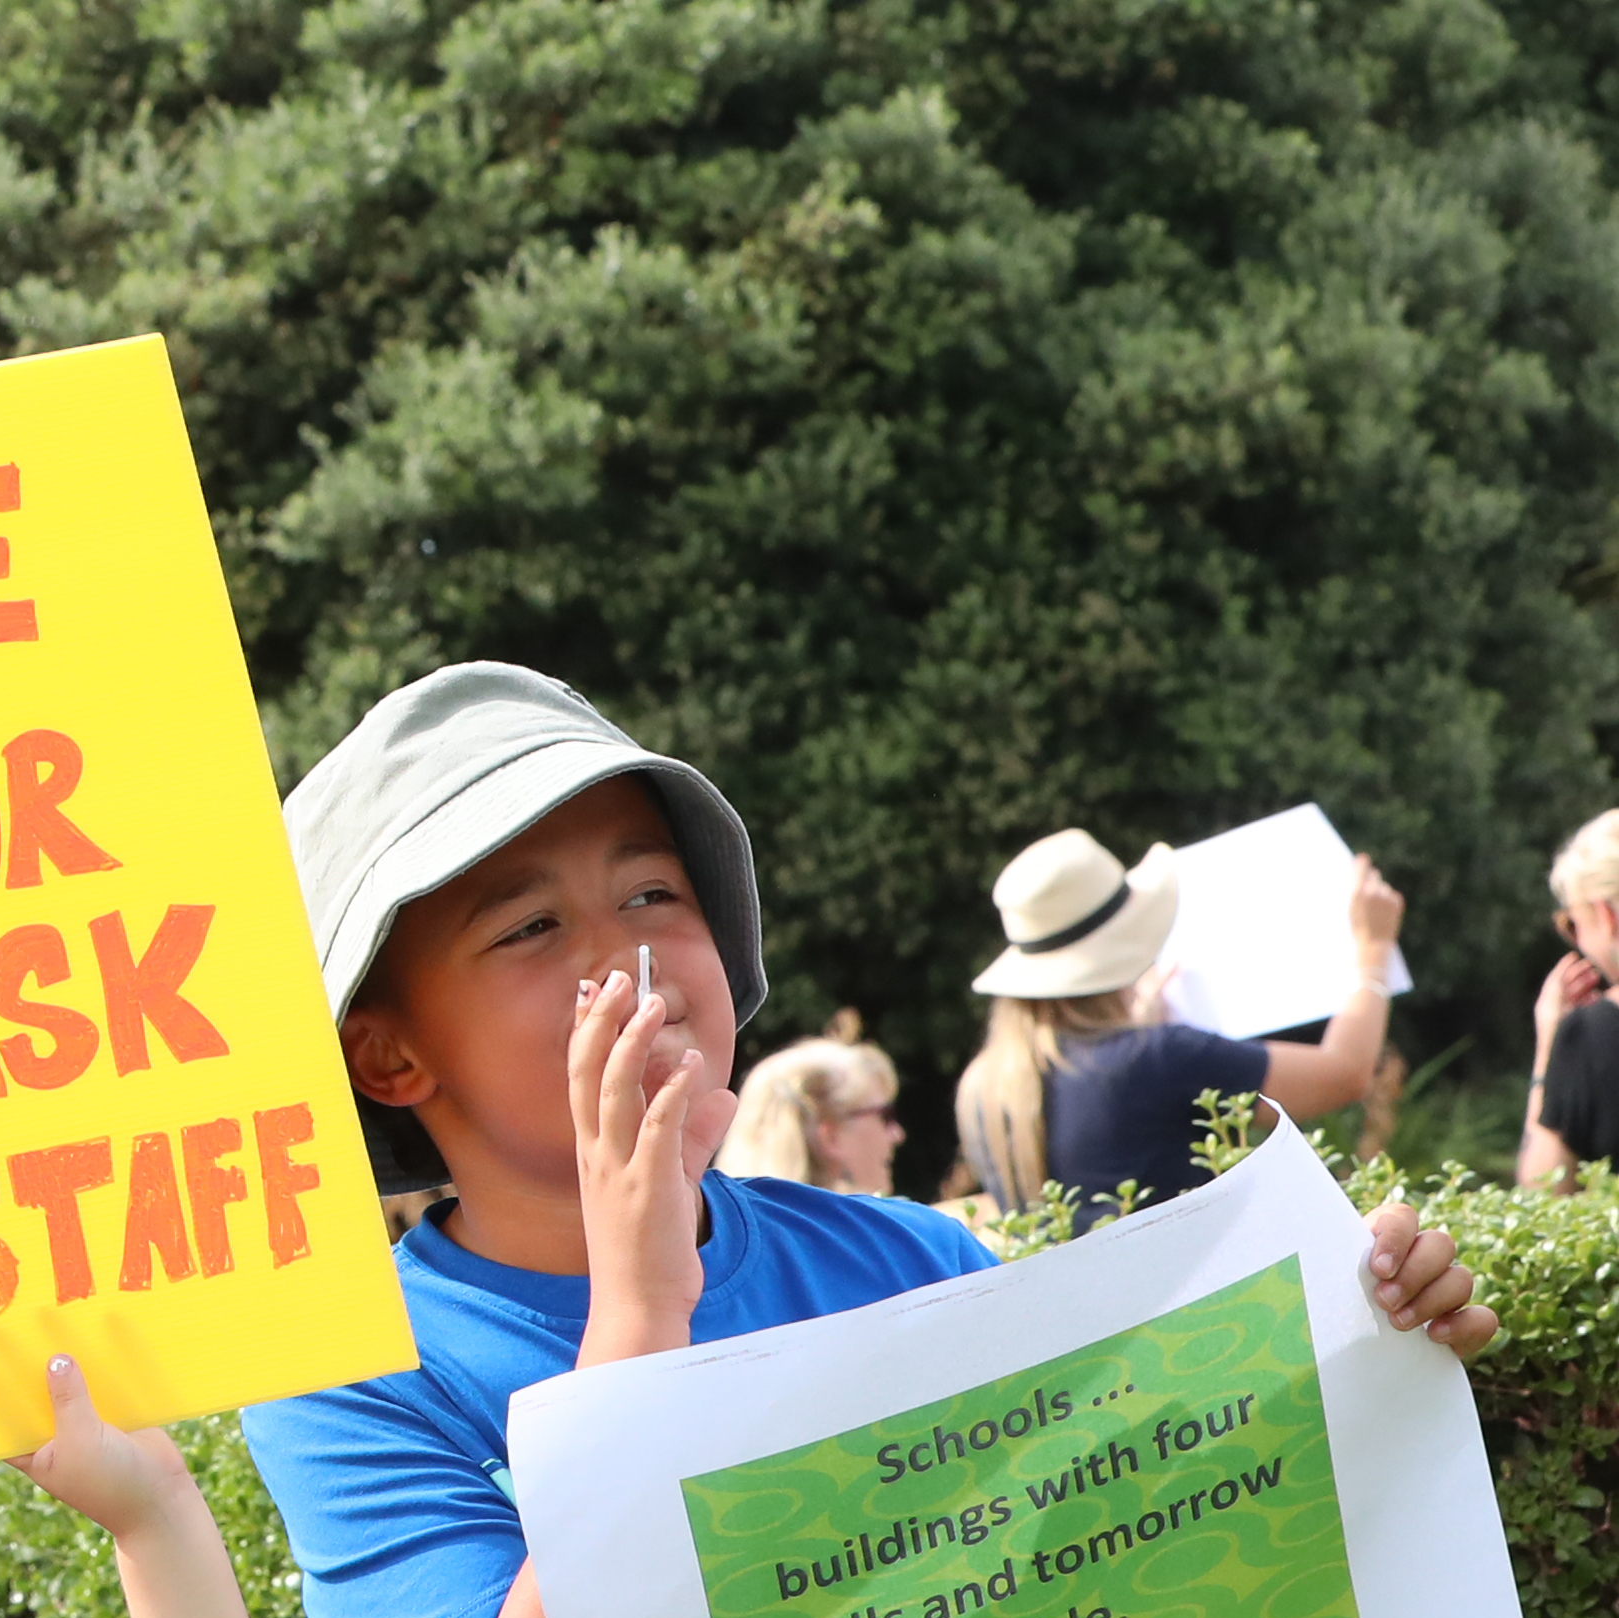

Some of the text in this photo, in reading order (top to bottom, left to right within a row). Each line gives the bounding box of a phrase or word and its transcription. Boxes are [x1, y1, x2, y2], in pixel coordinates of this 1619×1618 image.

[775, 1394, 1255, 1601] buildings with four
[877, 1388, 1074, 1484] Schools
[1031, 1456, 1283, 1583] tomorrow
